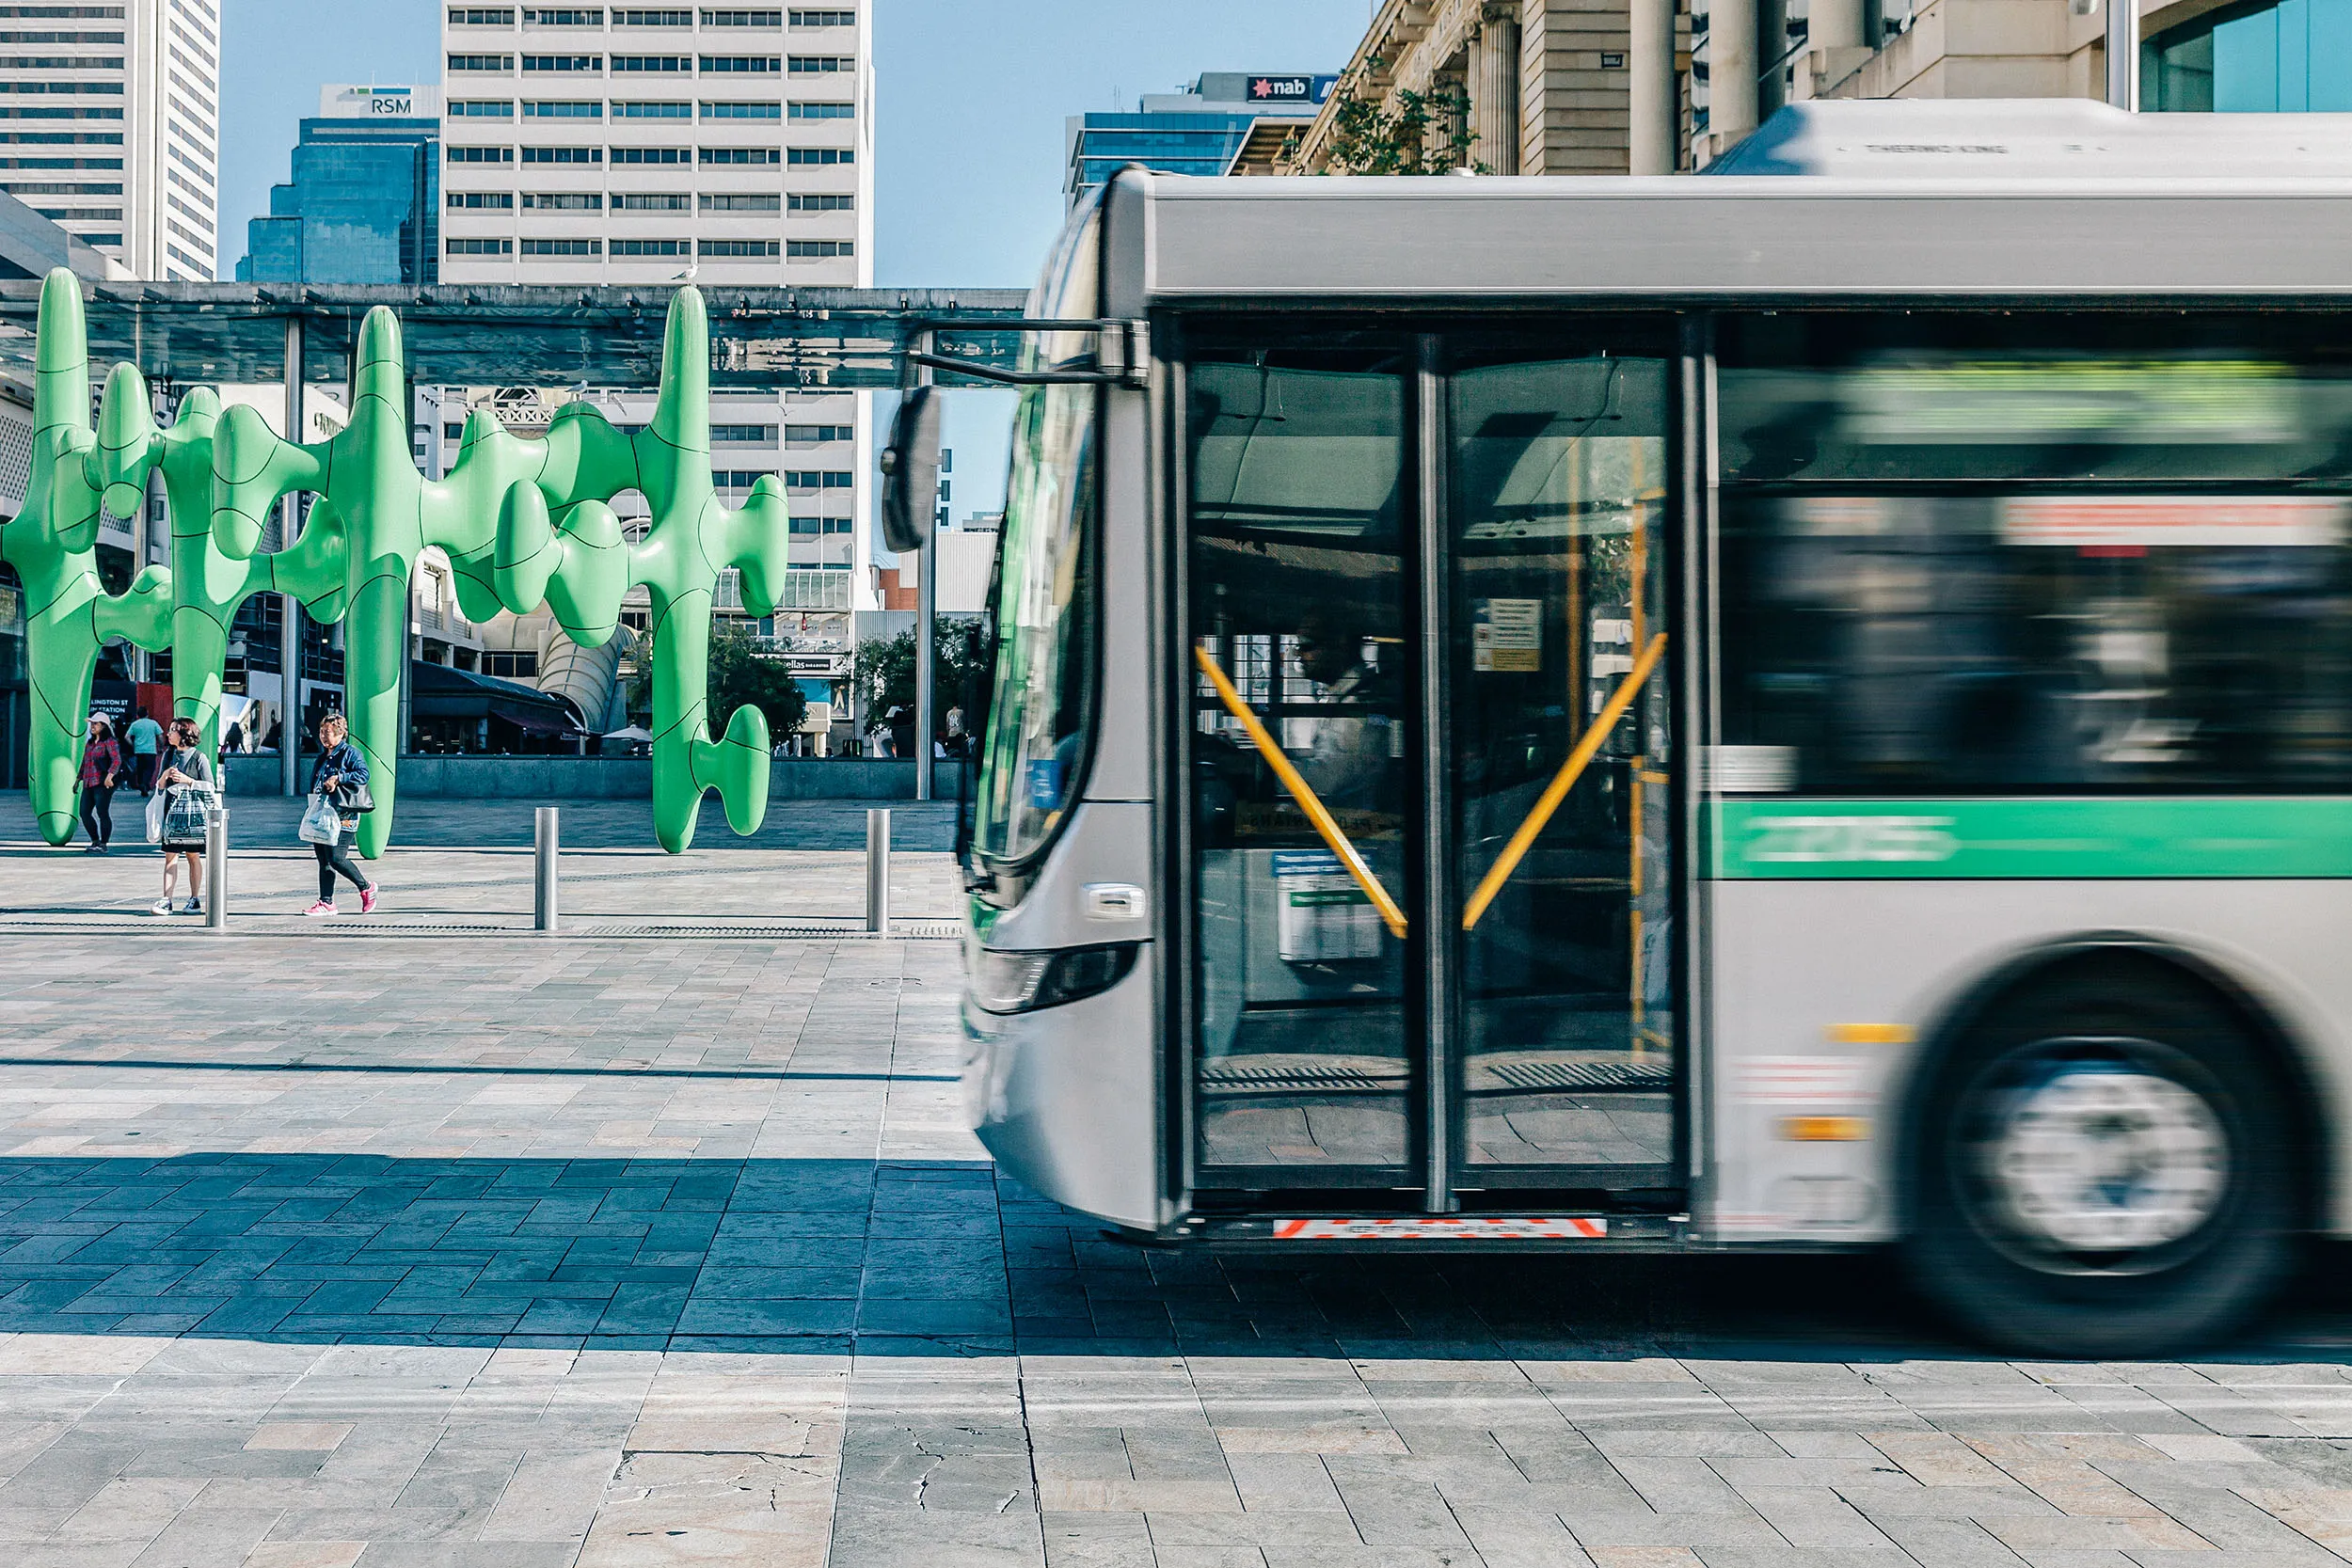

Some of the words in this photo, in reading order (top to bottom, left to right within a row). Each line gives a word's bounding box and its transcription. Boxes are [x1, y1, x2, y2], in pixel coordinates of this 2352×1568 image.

[1273, 78, 1306, 95] nab
[372, 99, 411, 114] RSM
[783, 659, 805, 669] ellas
